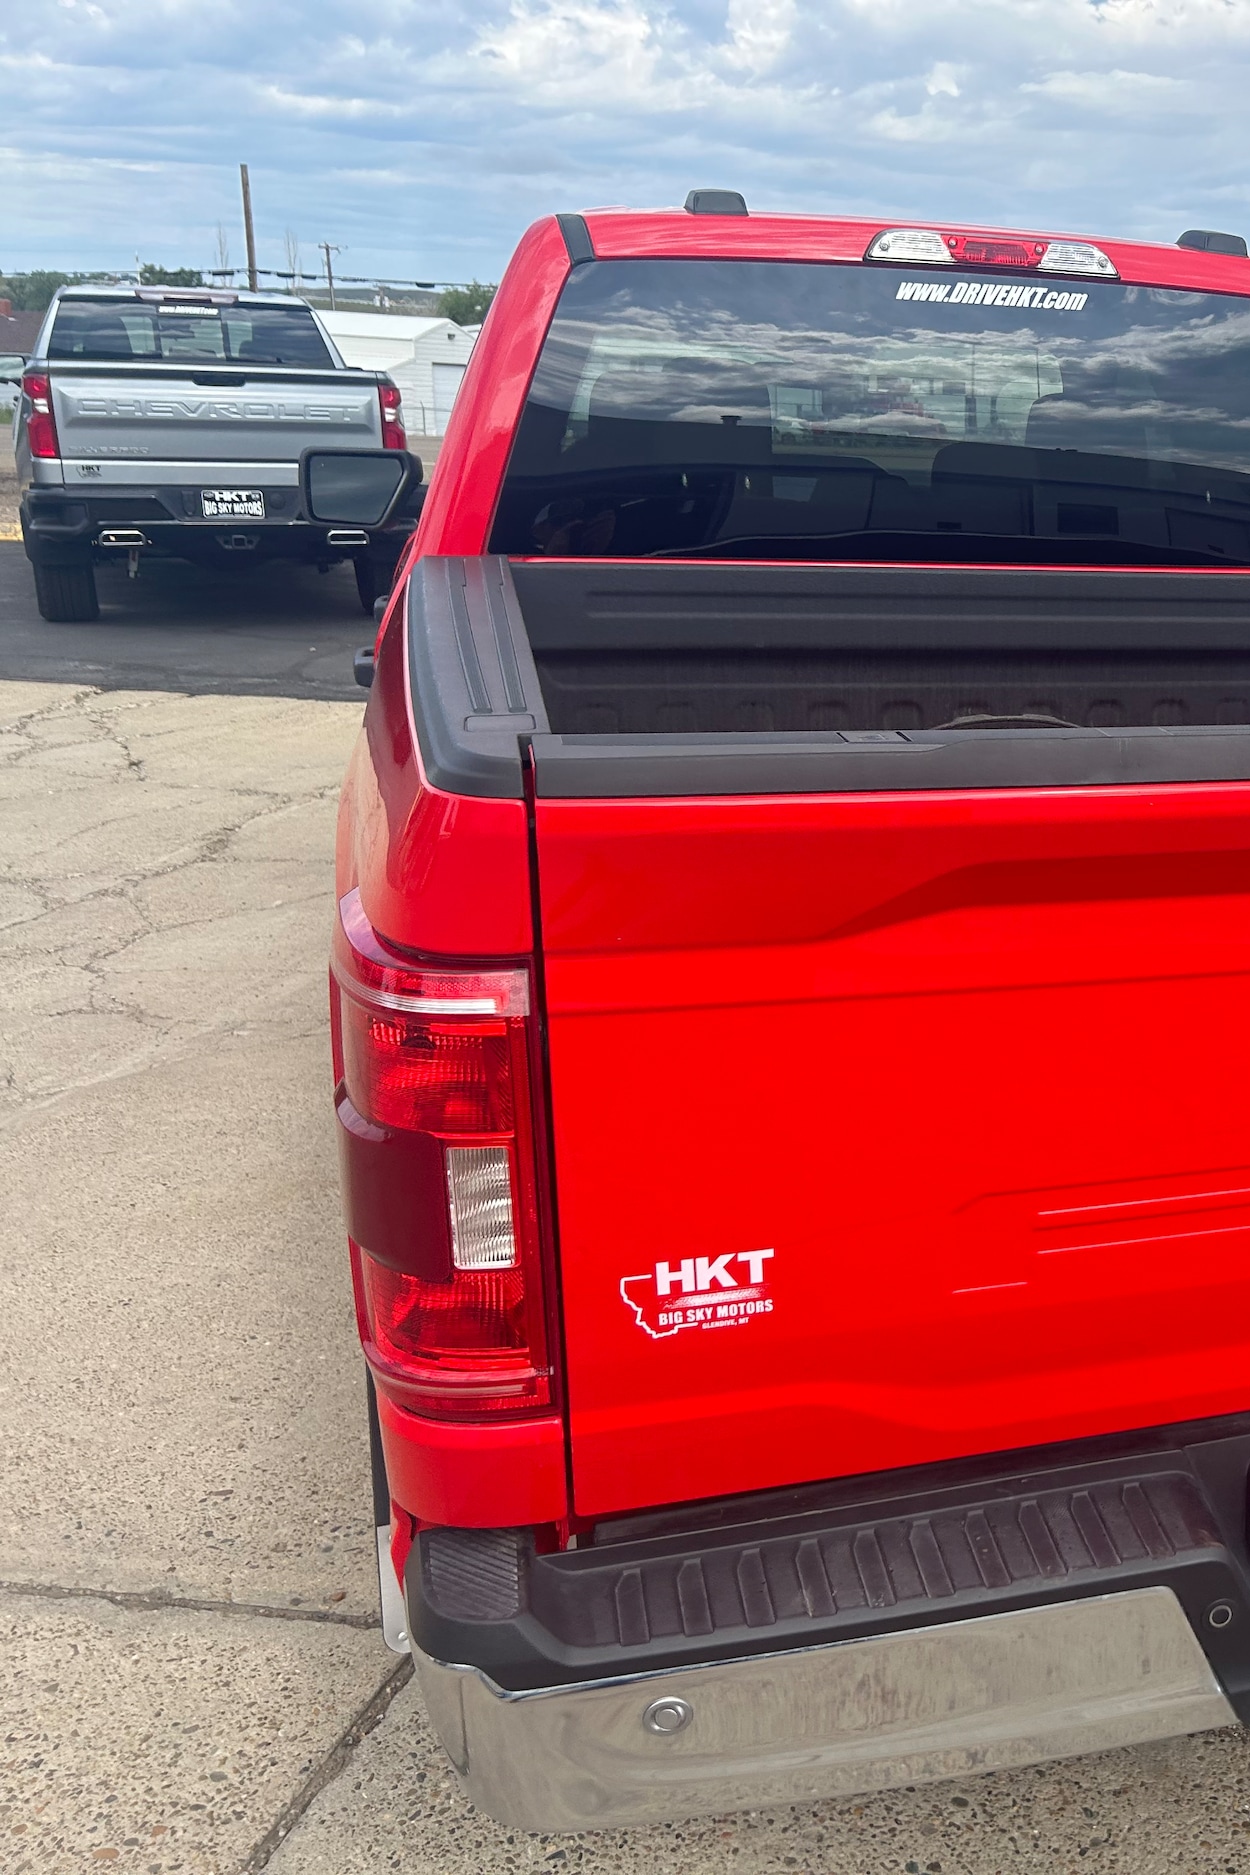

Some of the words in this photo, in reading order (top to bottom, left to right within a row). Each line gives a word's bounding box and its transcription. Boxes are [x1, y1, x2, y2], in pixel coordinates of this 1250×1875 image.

[895, 281, 1088, 311] www.DRIVEHKT.com
[77, 398, 360, 422] CHEVROLET
[204, 500, 217, 516] BIG
[218, 502, 232, 514] SKY
[233, 500, 262, 516] MOTORS
[213, 491, 249, 502] HKT
[655, 1248, 775, 1296] HKT
[658, 1311, 683, 1326] BIG
[686, 1307, 713, 1322] SKY
[716, 1299, 774, 1318] MOTORS
